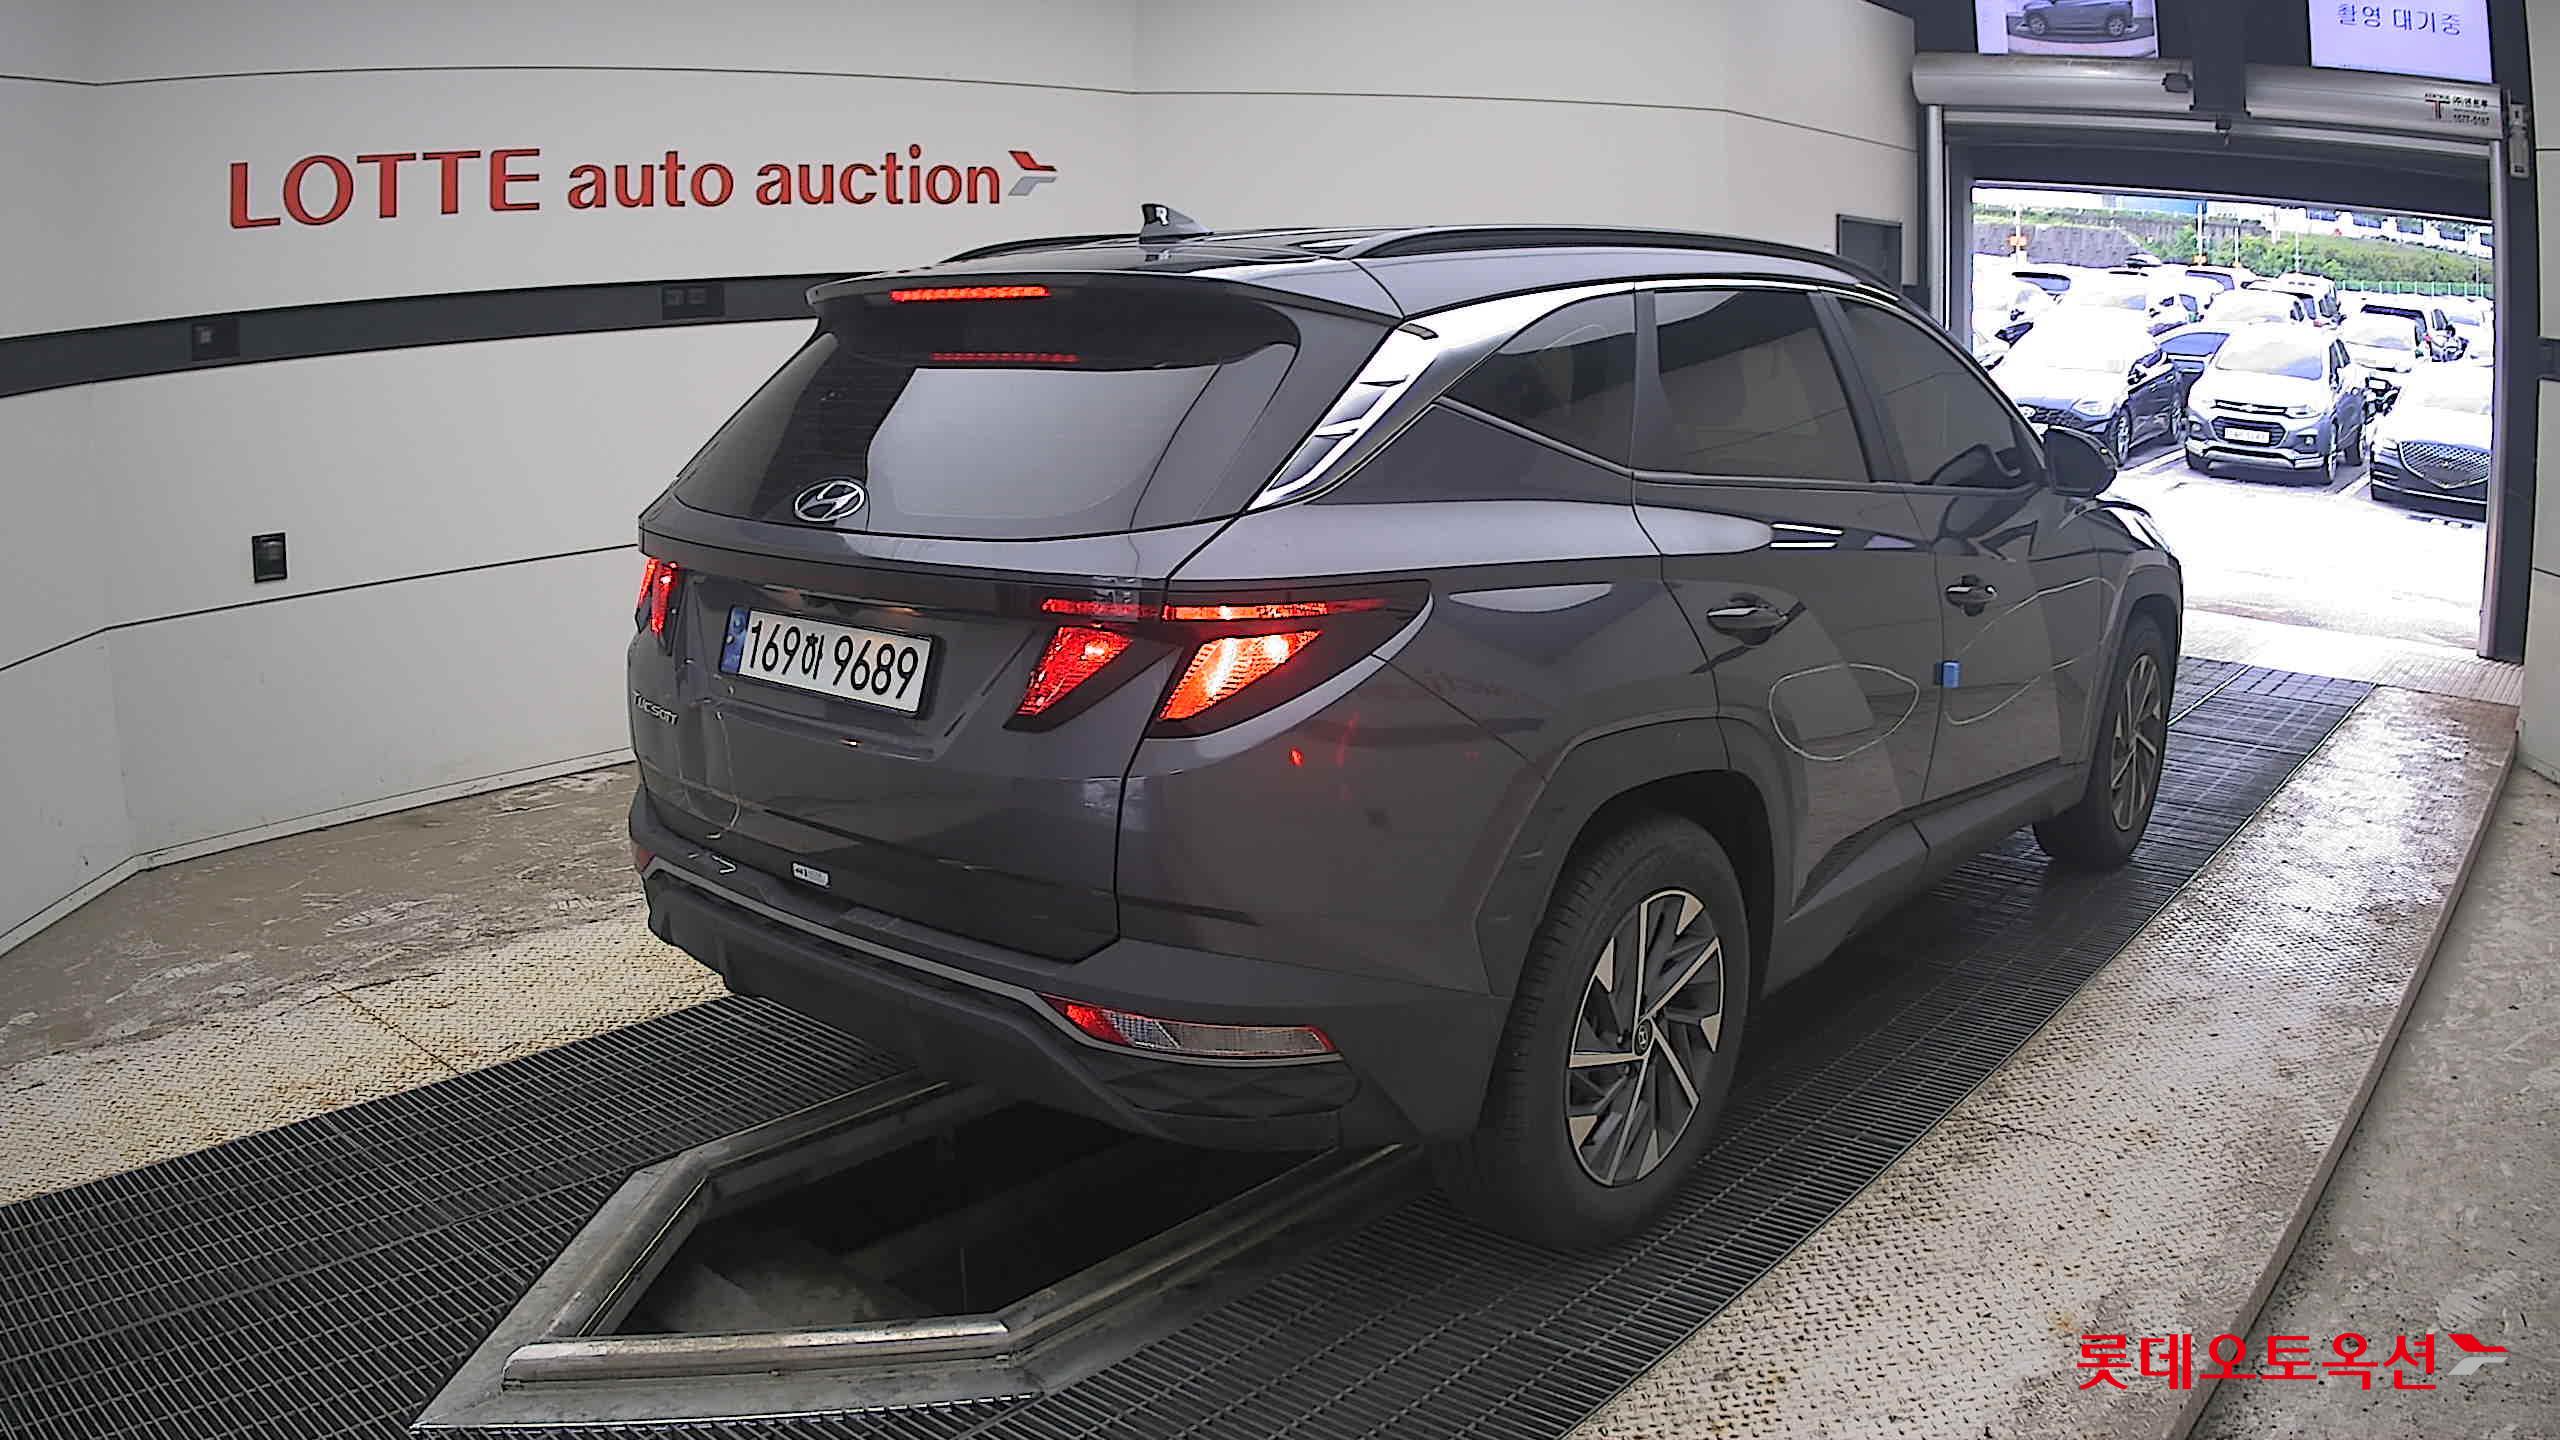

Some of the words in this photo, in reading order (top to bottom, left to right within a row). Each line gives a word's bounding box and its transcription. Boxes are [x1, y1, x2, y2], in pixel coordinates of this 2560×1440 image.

[2393, 9, 2461, 35] 대기중
[230, 147, 541, 229] LOTTE
[567, 149, 735, 208] auto
[755, 145, 1002, 206] auction
[751, 620, 824, 680] 169하
[833, 635, 918, 699] 9689
